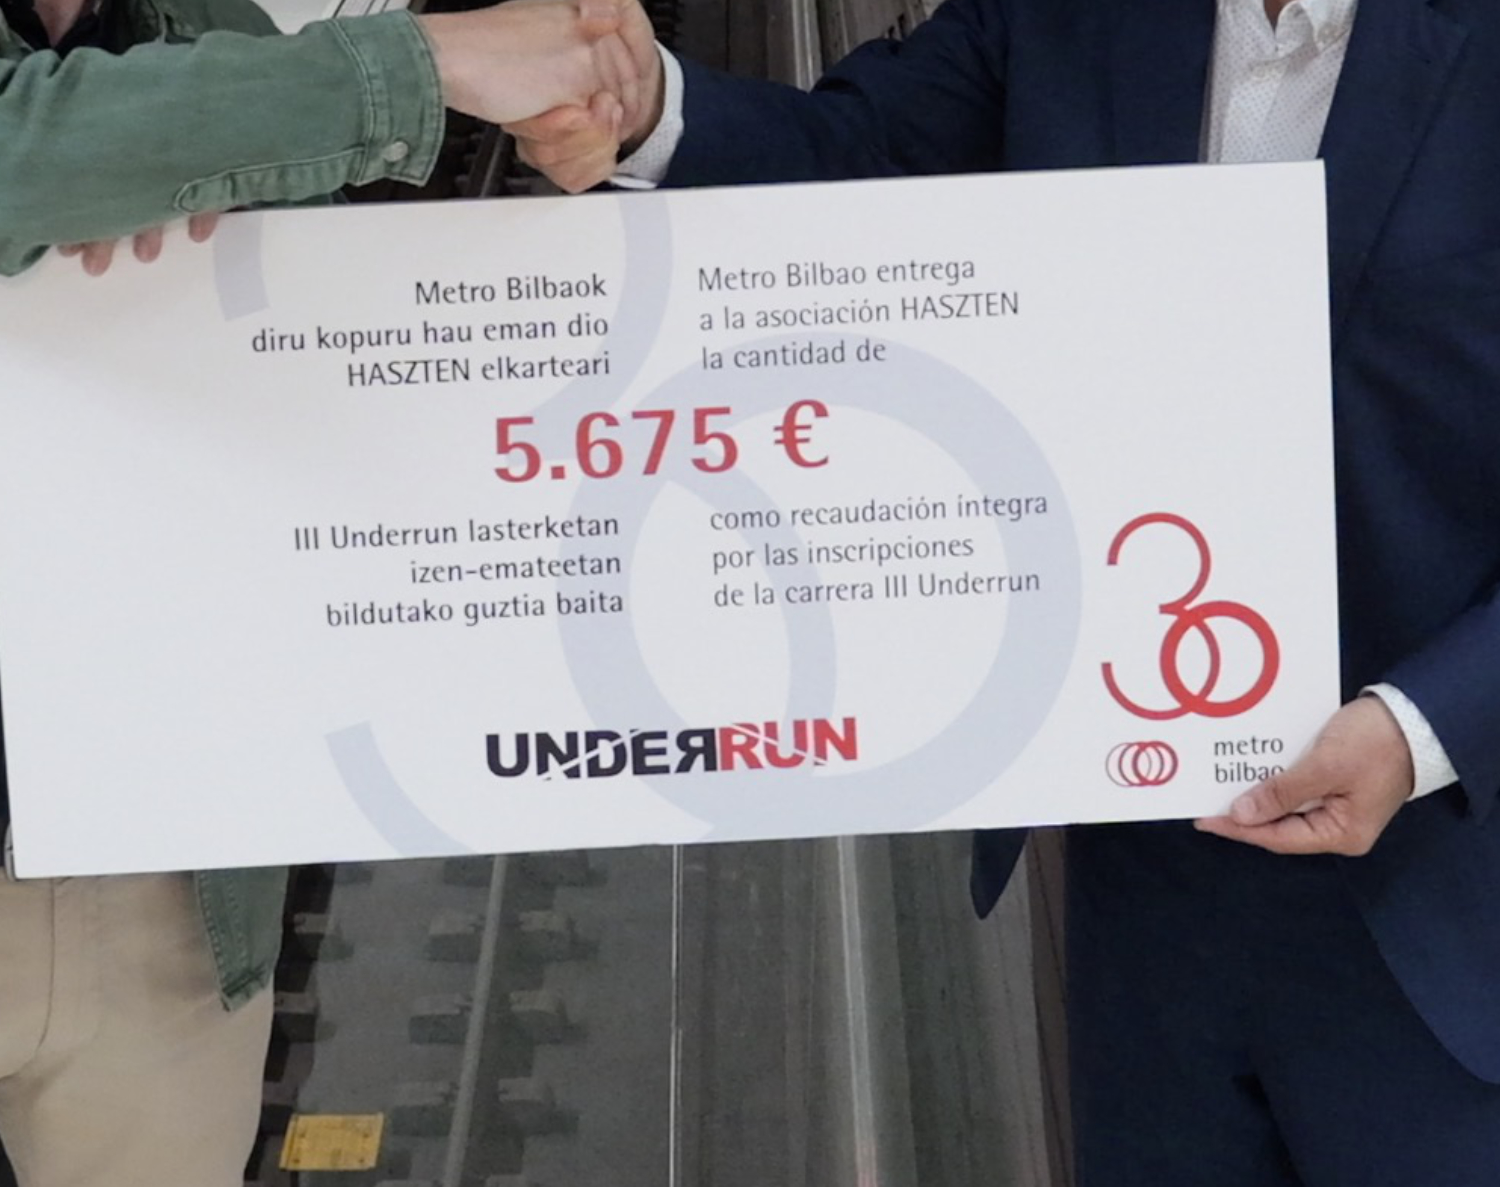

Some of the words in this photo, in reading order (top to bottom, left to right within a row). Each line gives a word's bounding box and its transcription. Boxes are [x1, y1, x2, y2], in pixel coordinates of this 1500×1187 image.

[415, 280, 496, 305] Metro
[506, 272, 607, 301] Bilbaok
[698, 266, 776, 292] Metro
[786, 261, 867, 288] Bilbao
[876, 260, 975, 287] entrega
[699, 313, 713, 332] a
[724, 305, 745, 330] la
[755, 298, 890, 328] asociación
[901, 291, 1019, 320] HASZTEN
[251, 327, 305, 353] diru
[316, 325, 412, 355] kopuru
[422, 320, 472, 345] hau
[483, 320, 556, 342] eman
[567, 312, 609, 338] dio
[347, 358, 470, 387] HASZTEN
[481, 350, 610, 381] elkarteari
[702, 346, 724, 371] la
[733, 339, 846, 369] cantidad
[855, 338, 886, 363] de
[494, 406, 739, 483] 5.675
[773, 399, 830, 469] €
[710, 509, 781, 531] como
[791, 496, 947, 526] recaudación
[957, 494, 1048, 523] íntegra
[294, 526, 320, 551] III
[330, 523, 458, 549] Underrun
[468, 515, 619, 542] lasterketan
[411, 554, 622, 584] izen-emateetan
[712, 549, 756, 576] por
[764, 542, 799, 567] las
[807, 535, 974, 567] inscripciones
[713, 583, 744, 608] de
[754, 581, 775, 606] la
[784, 582, 874, 605] carrera
[884, 574, 908, 599] III
[918, 571, 1041, 597] Underrun
[326, 598, 454, 627] bildutako
[463, 593, 545, 627] guztia
[556, 590, 623, 615] baita
[485, 716, 858, 780] UNDERRUN
[1214, 736, 1283, 756] metro
